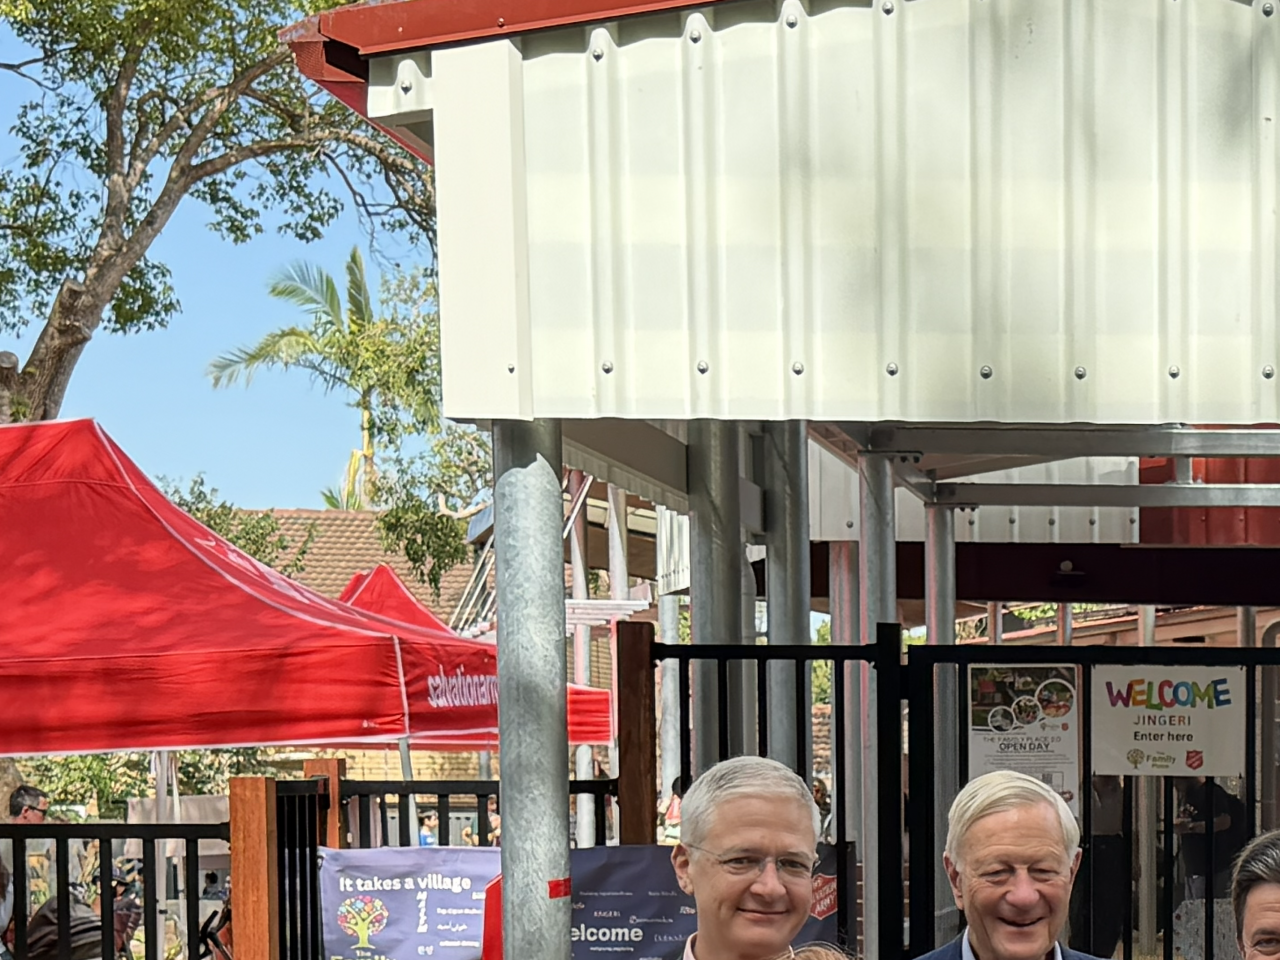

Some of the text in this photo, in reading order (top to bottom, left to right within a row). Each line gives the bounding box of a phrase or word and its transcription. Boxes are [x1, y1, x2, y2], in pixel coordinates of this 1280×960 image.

[427, 664, 498, 708] salvationarm
[1105, 678, 1232, 711] WELCOME
[1133, 715, 1192, 726] JINGERI
[1133, 731, 1194, 742] Enter here
[998, 742, 1051, 751] OPEN DAY
[339, 874, 472, 893] It takes a village
[571, 923, 644, 942] elcome
